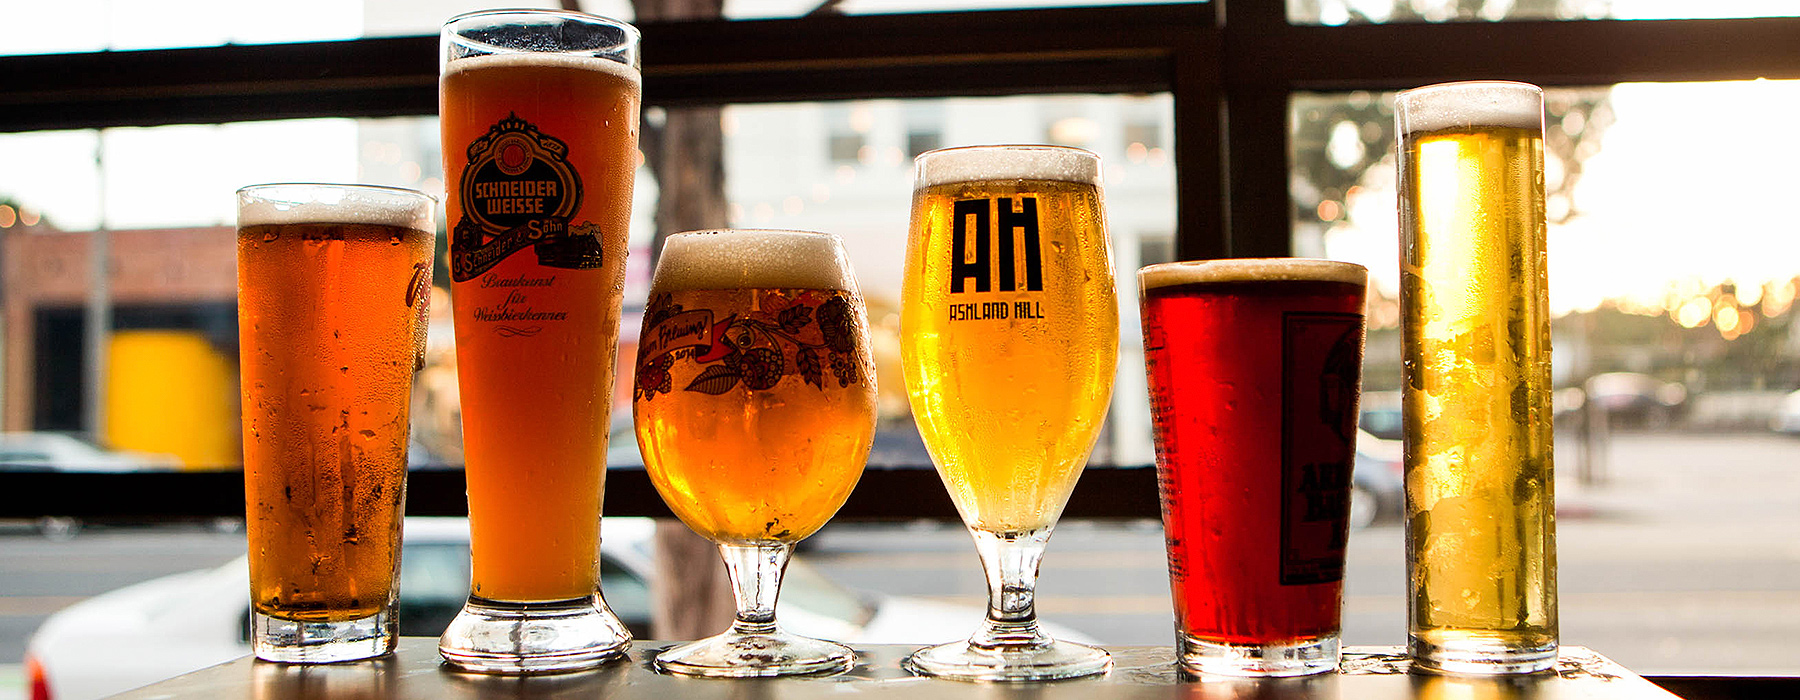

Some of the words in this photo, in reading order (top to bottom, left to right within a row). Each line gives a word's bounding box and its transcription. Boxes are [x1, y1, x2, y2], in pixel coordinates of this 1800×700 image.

[475, 180, 557, 199] SCHNEIDER
[487, 198, 544, 215] WEISSE
[950, 197, 1043, 293] AH
[463, 237, 513, 273] Schneider
[480, 273, 556, 289] Braukunst
[473, 306, 568, 322] Weissbierkenner
[949, 302, 1009, 321] ASHLAND
[1014, 301, 1045, 319] HILL
